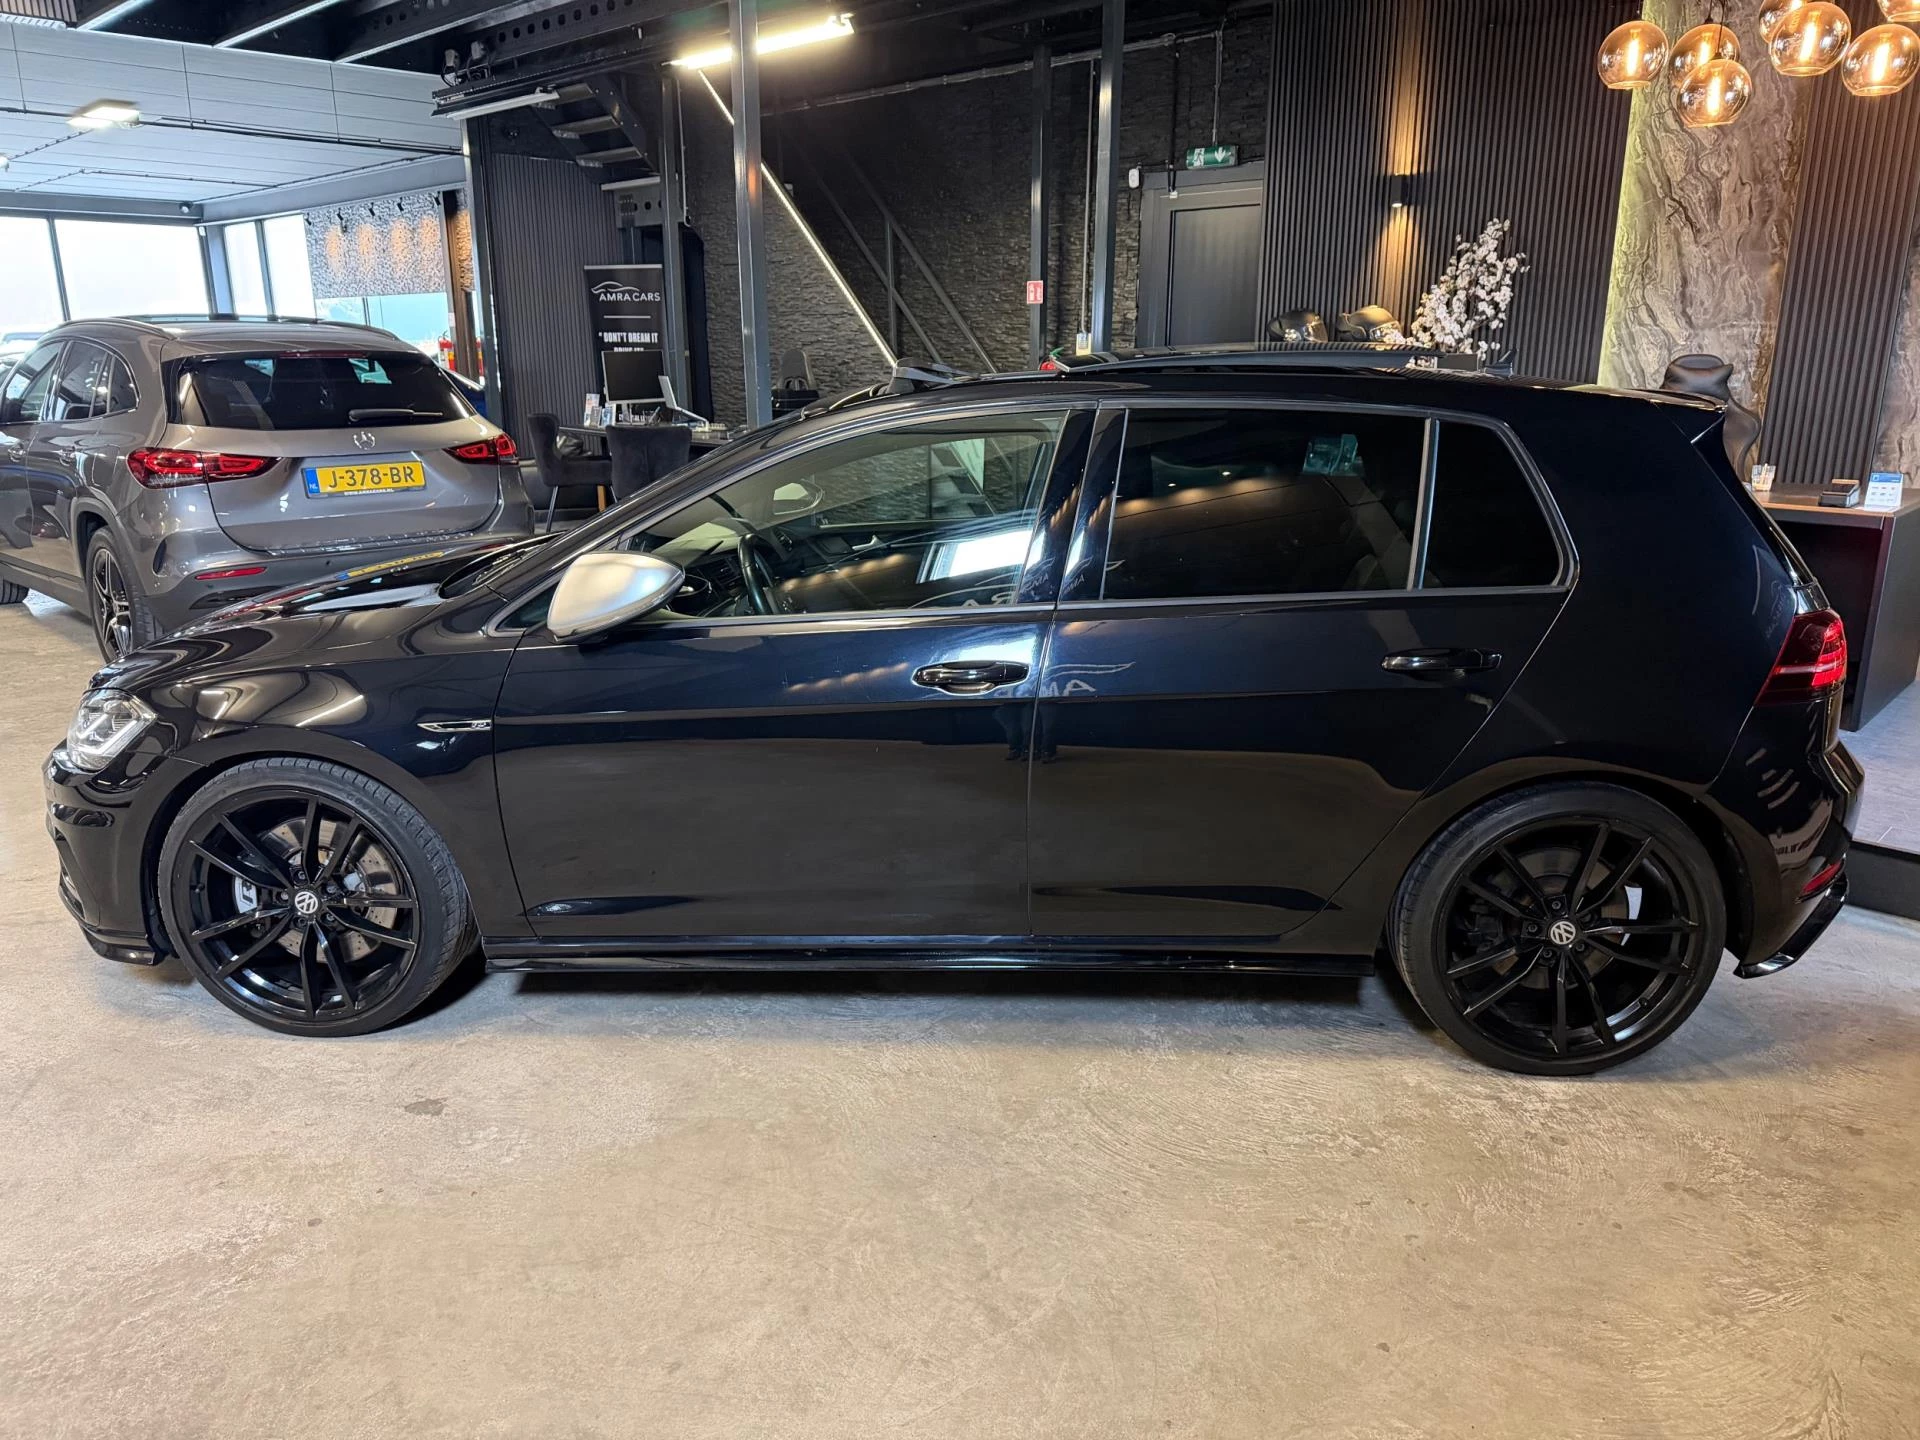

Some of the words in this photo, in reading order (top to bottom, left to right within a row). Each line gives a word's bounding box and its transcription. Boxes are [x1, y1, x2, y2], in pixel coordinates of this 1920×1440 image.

[599, 292, 631, 302] AMRA
[632, 292, 661, 302] CARS
[628, 332, 651, 343] DREAM
[651, 332, 658, 343] IT
[328, 466, 415, 488] J-378-BR
